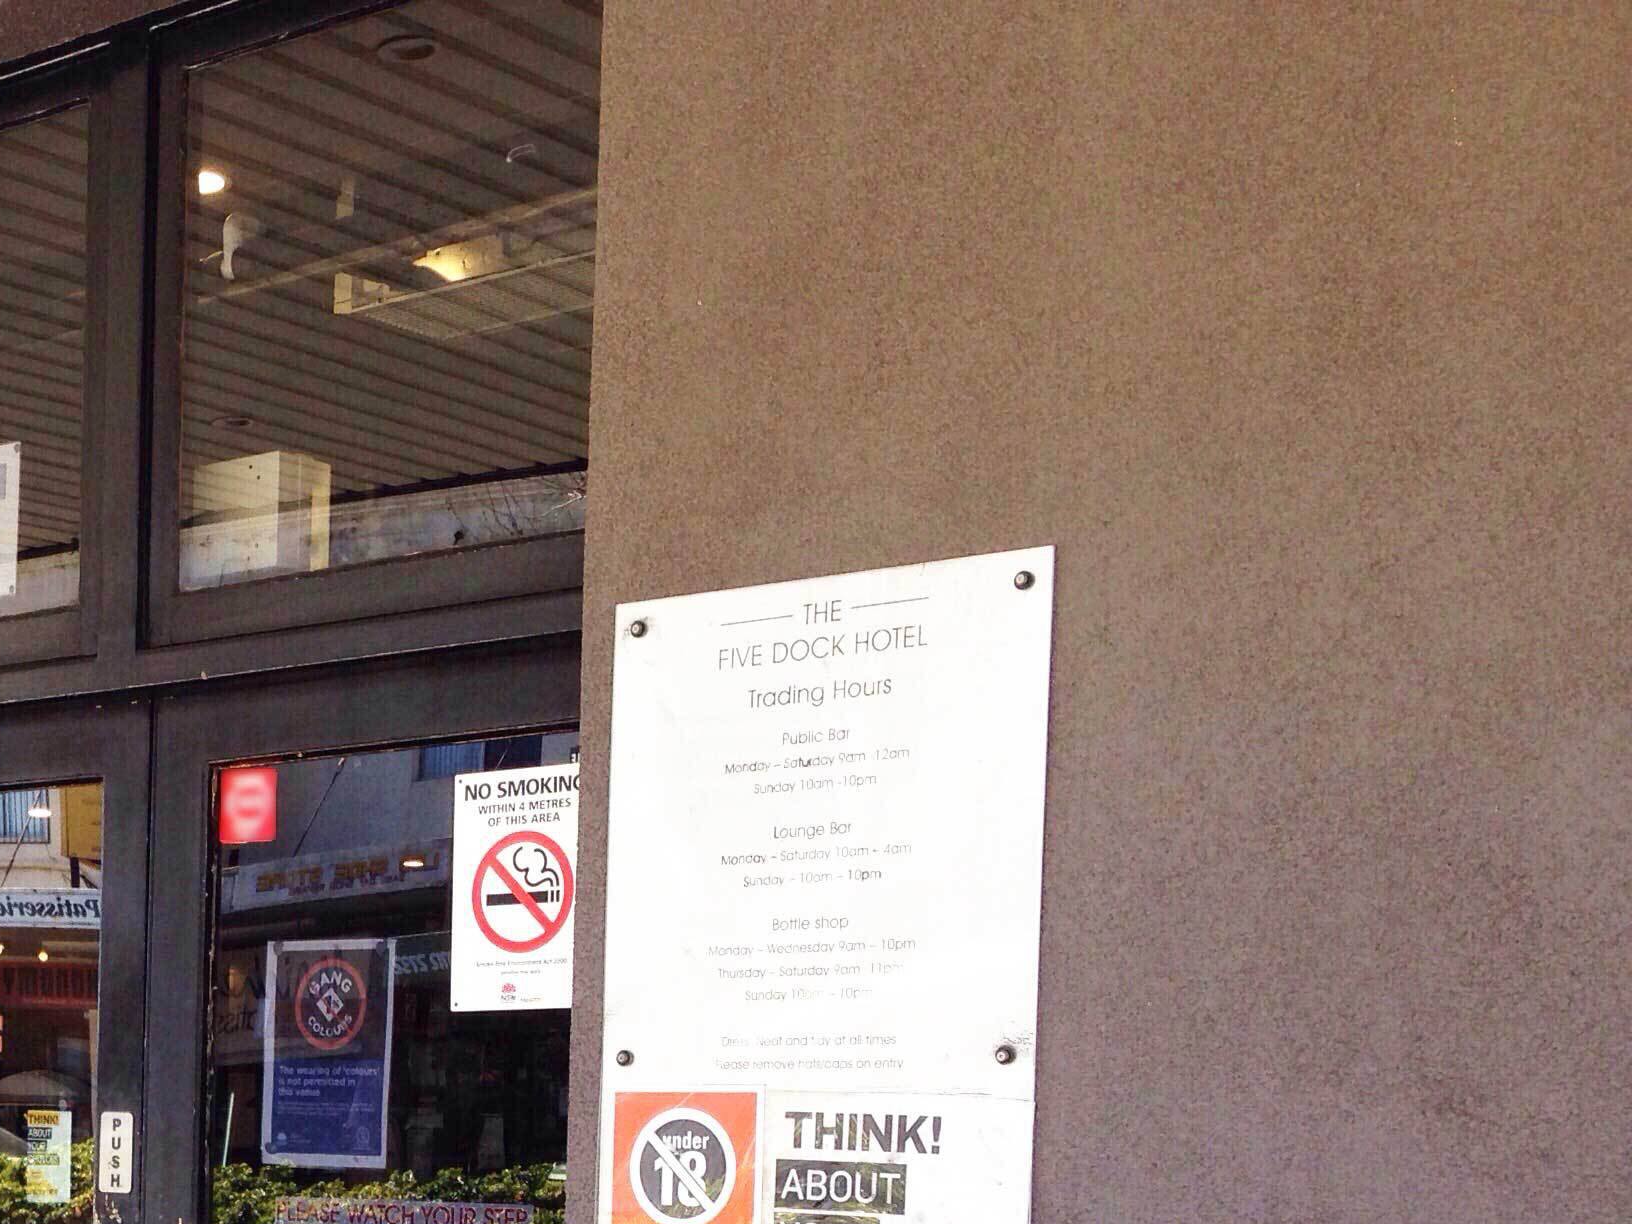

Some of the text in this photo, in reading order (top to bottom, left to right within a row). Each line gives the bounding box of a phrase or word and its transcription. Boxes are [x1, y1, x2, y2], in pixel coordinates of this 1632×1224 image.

[802, 600, 843, 626] THE
[717, 625, 928, 672] FIVE DOCK HOTEL
[747, 676, 893, 709] Trading Hours
[781, 728, 851, 746] Public Bar
[724, 747, 910, 776] Monday Saturday 9am 12am
[464, 783, 492, 802] NO
[753, 781, 796, 795] Sunday
[800, 777, 834, 791] 10am
[478, 797, 572, 815] WITHIN 4 METRES
[487, 811, 561, 828] OF THIS AREA
[773, 821, 852, 841] Lounge Bar
[720, 843, 913, 867] Monday Saturday 10am 4am
[743, 868, 882, 889] Sunday 10am 10pm
[771, 914, 850, 932] Bottle shop
[708, 936, 917, 957] Monday Wednesday 9am 10pm
[308, 970, 353, 996] GANG
[717, 967, 767, 980] Thursday
[778, 965, 831, 977] Saturday
[744, 989, 786, 1002] Sunday
[307, 1014, 353, 1039] COLOURS
[279, 1065, 294, 1076] The
[295, 1066, 331, 1078] wearing
[287, 1078, 302, 1087] not
[303, 1077, 346, 1088] permitted
[28, 1113, 60, 1125] THINK!
[662, 1131, 710, 1153] under
[784, 1110, 943, 1155] THINK!
[111, 1117, 124, 1189] PUSH
[654, 1150, 709, 1208] 18
[780, 1168, 902, 1205] ABOUT
[275, 1201, 340, 1224] PLEASE
